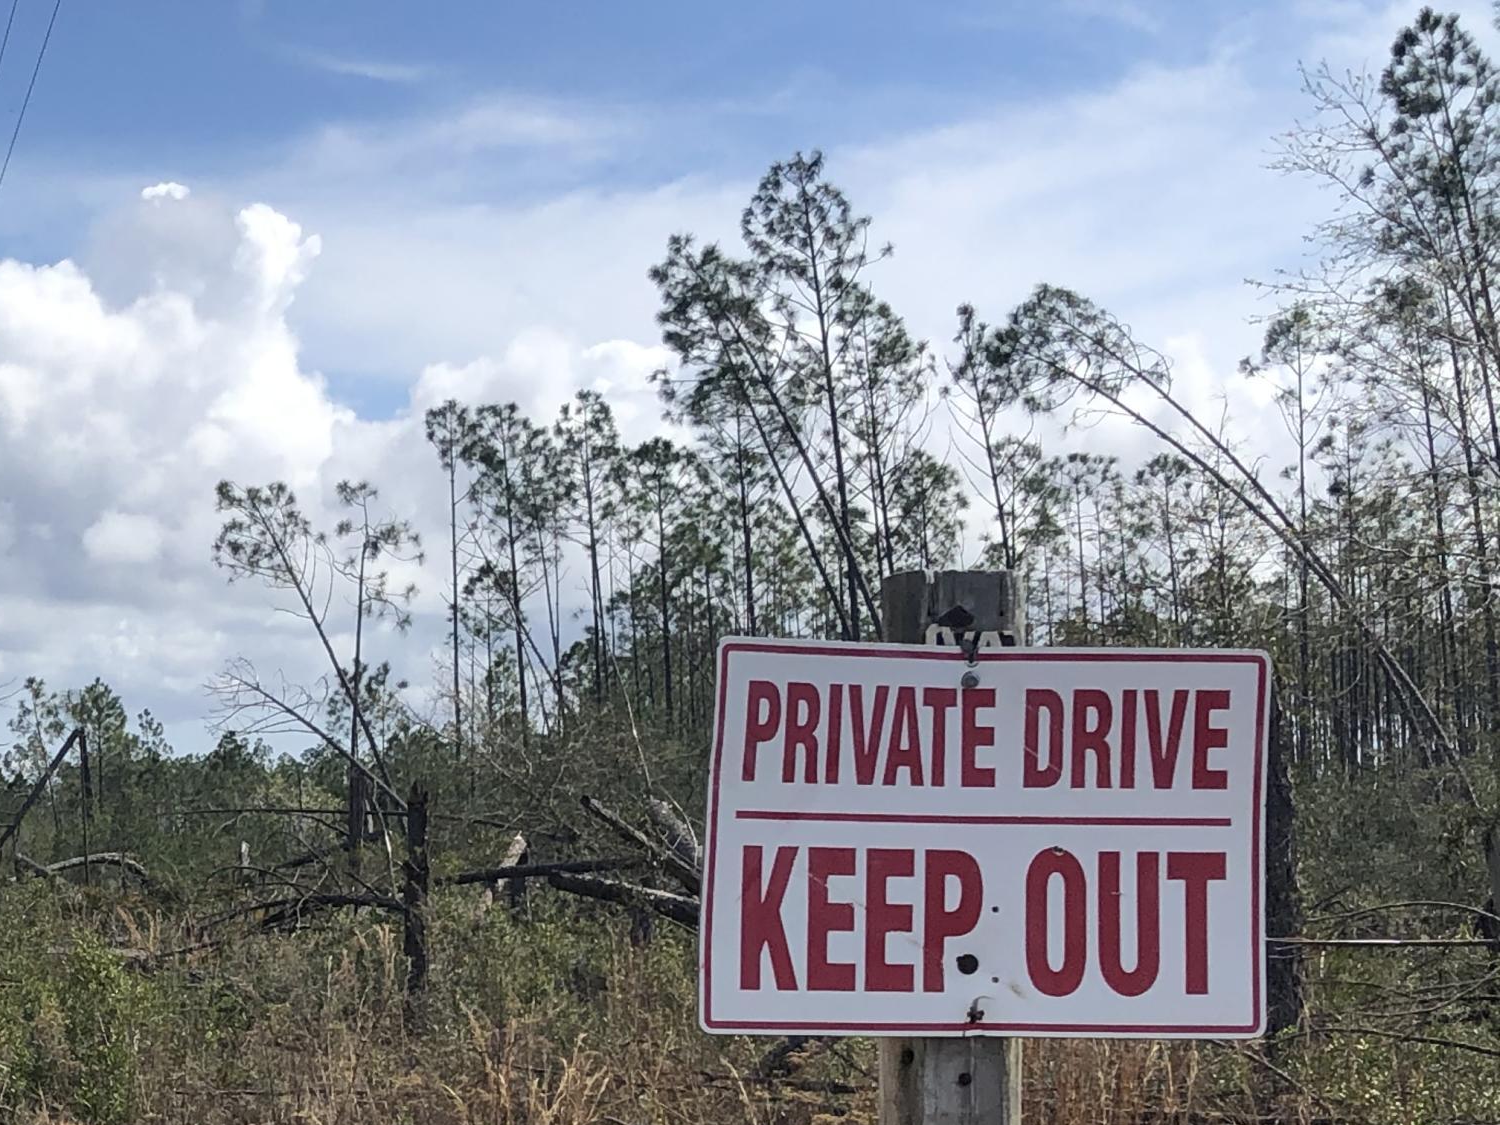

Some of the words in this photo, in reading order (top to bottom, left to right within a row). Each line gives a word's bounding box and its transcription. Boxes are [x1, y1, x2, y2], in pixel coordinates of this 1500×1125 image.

[741, 680, 996, 787] PRIVATE
[1023, 688, 1230, 790] DRIVE
[739, 845, 983, 992] KEEP
[1025, 847, 1227, 997] OUT
